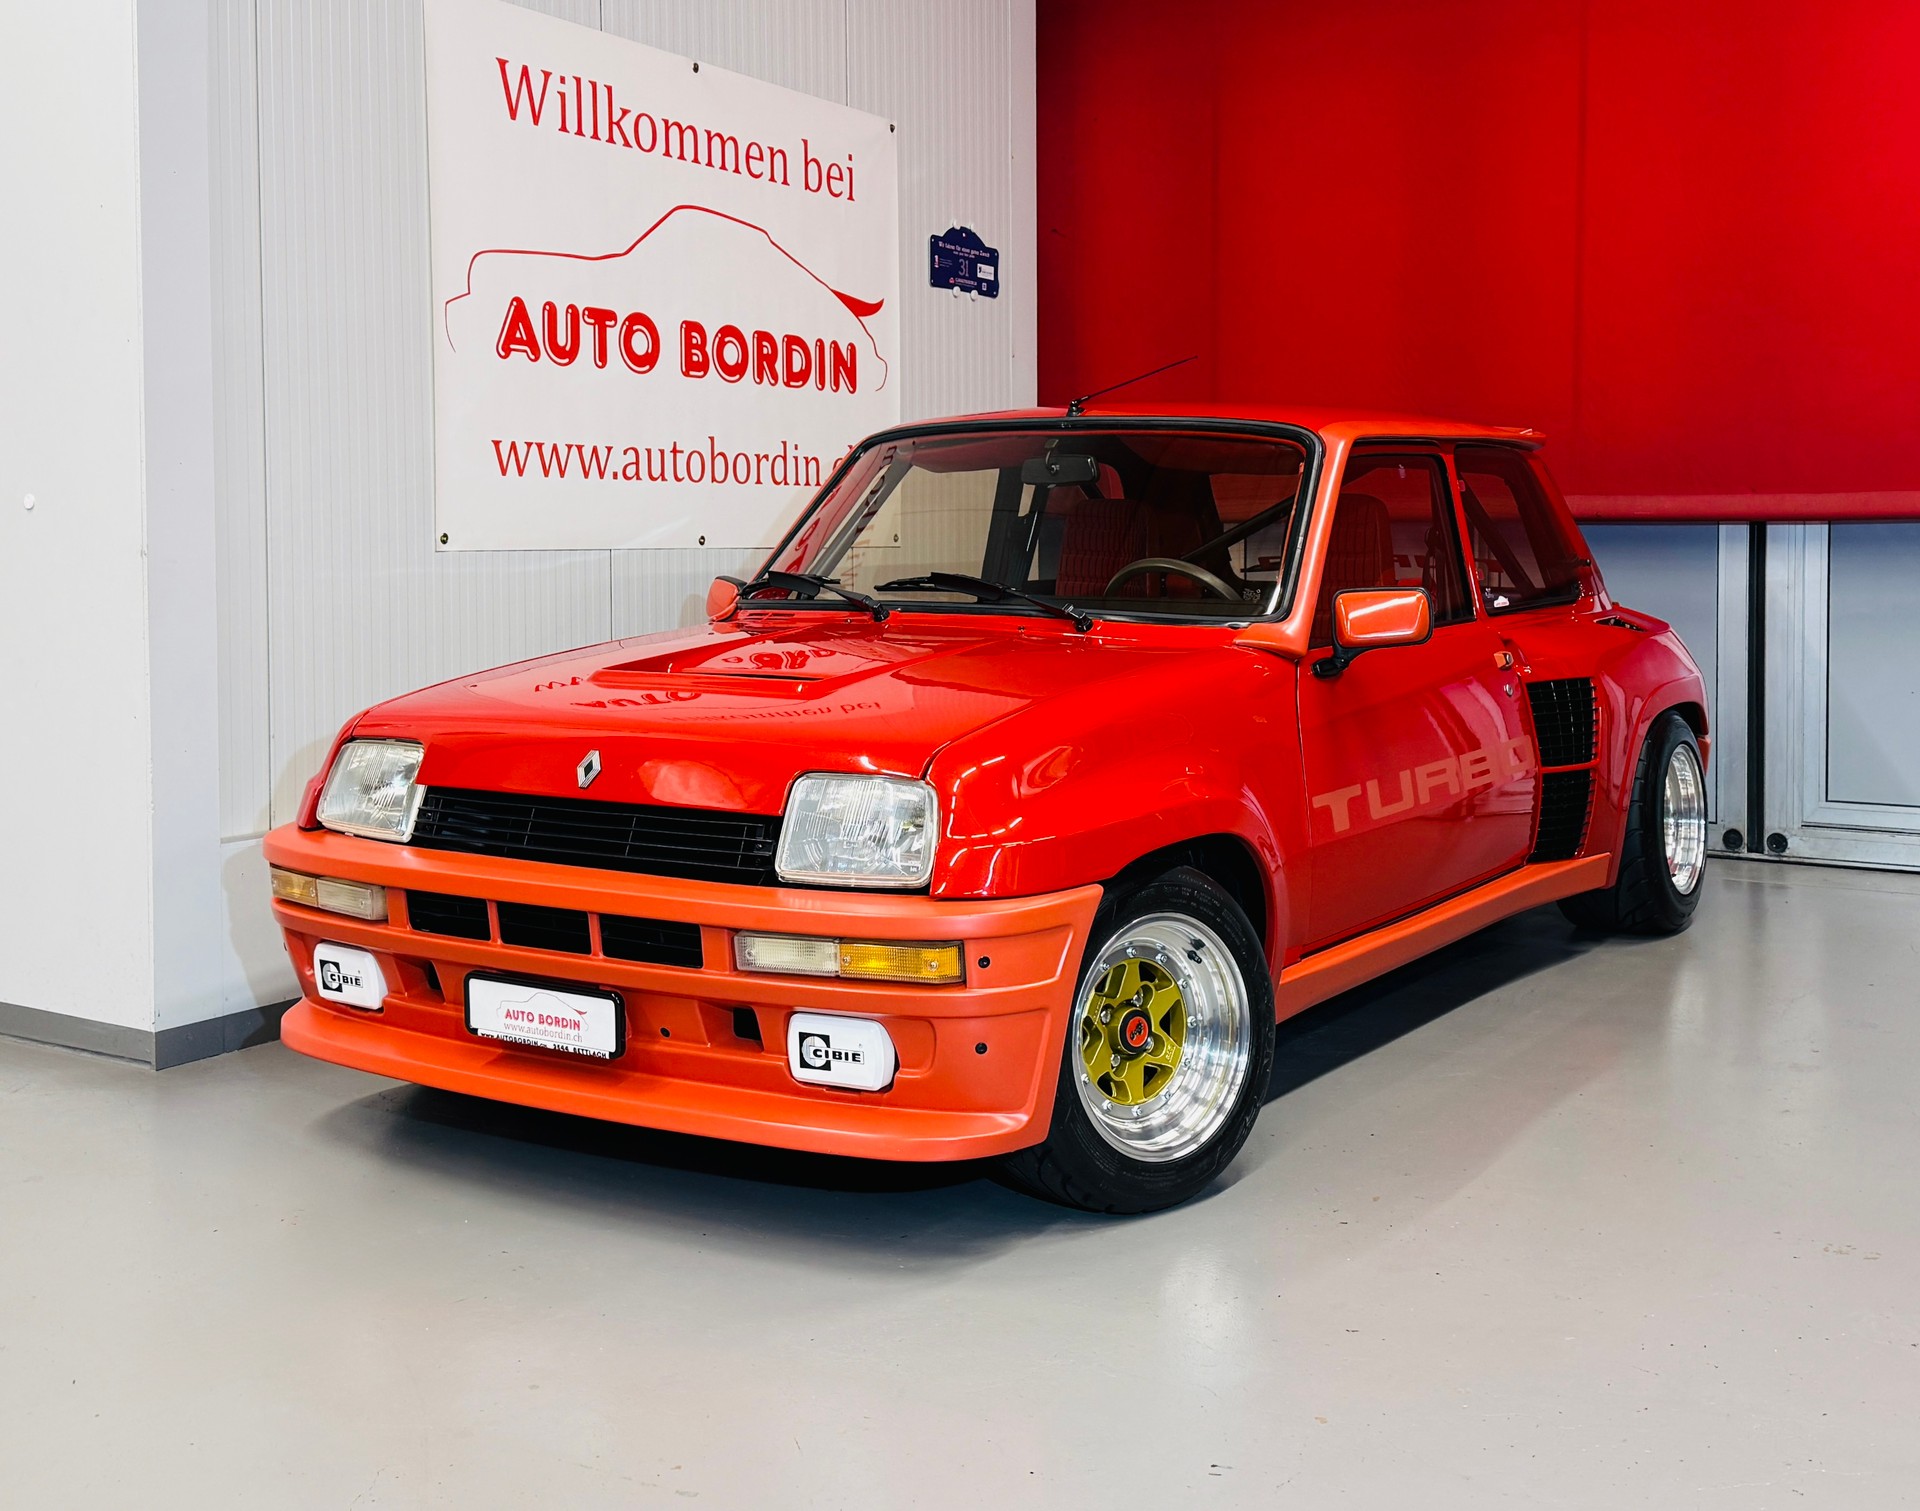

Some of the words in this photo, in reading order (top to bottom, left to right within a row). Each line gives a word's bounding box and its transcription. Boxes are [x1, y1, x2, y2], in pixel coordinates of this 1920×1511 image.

[496, 57, 791, 186] Willkommen
[802, 138, 856, 201] bei
[958, 258, 969, 277] 31
[496, 296, 661, 374] AUTO
[680, 319, 857, 394] BORDIN
[1312, 735, 1536, 833] TURBO
[330, 973, 361, 986] CIBIE
[505, 1008, 535, 1023] AUTO
[538, 1013, 581, 1031] BORDIN
[503, 1022, 583, 1043] www.autobordin.ch
[812, 1048, 861, 1063] CIBIE
